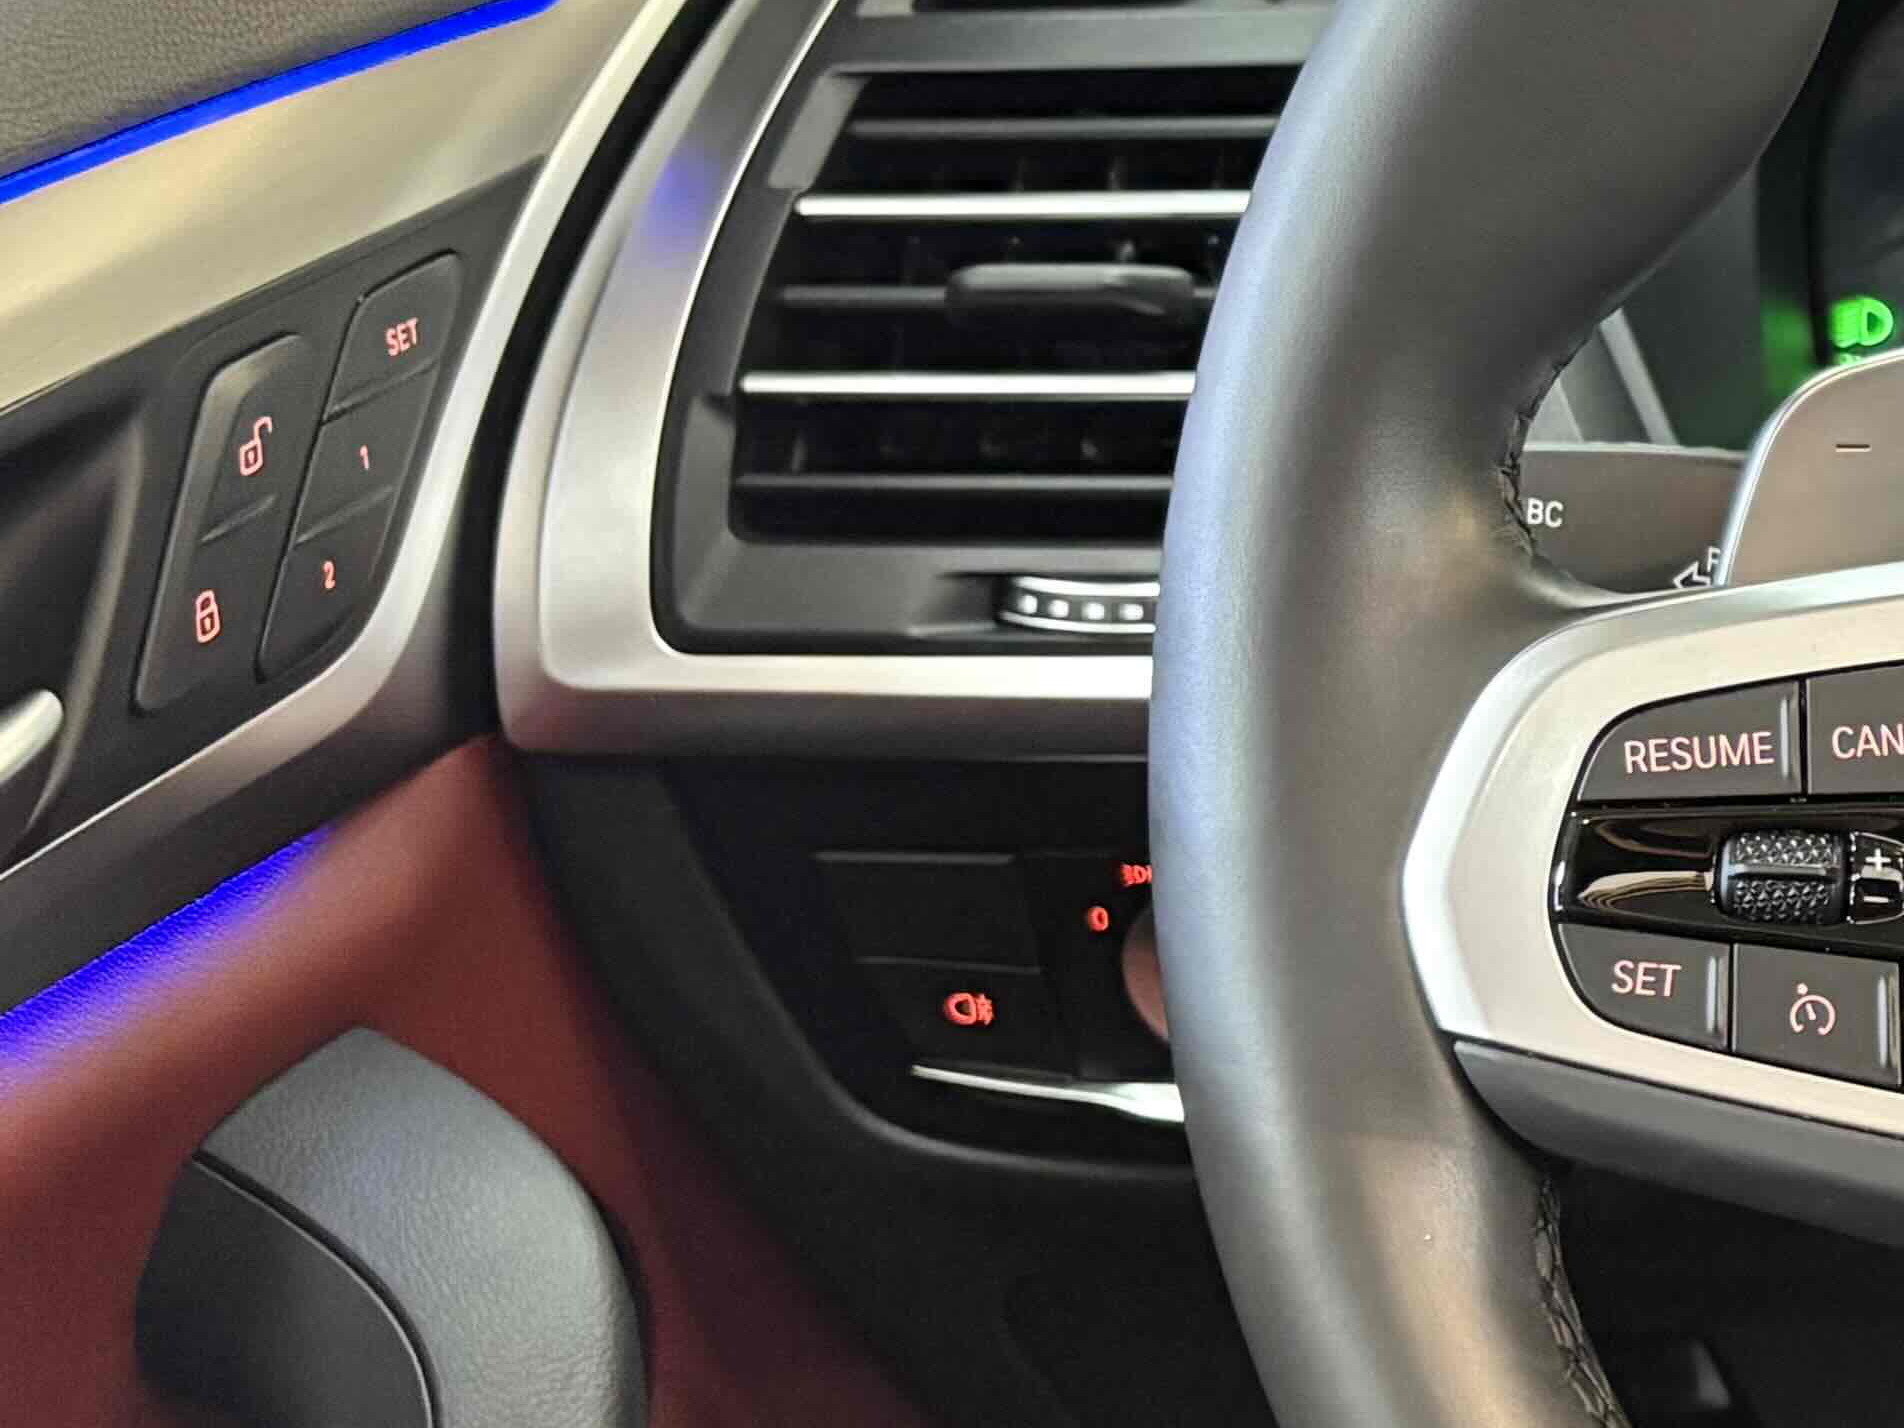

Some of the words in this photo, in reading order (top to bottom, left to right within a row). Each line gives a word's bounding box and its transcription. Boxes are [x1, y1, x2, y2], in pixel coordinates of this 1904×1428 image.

[385, 317, 419, 357] SET
[359, 445, 371, 470] 1
[1526, 497, 1564, 528] BC
[322, 561, 336, 589] 2
[1623, 730, 1776, 774] RESUME
[1611, 960, 1682, 1000] SET
